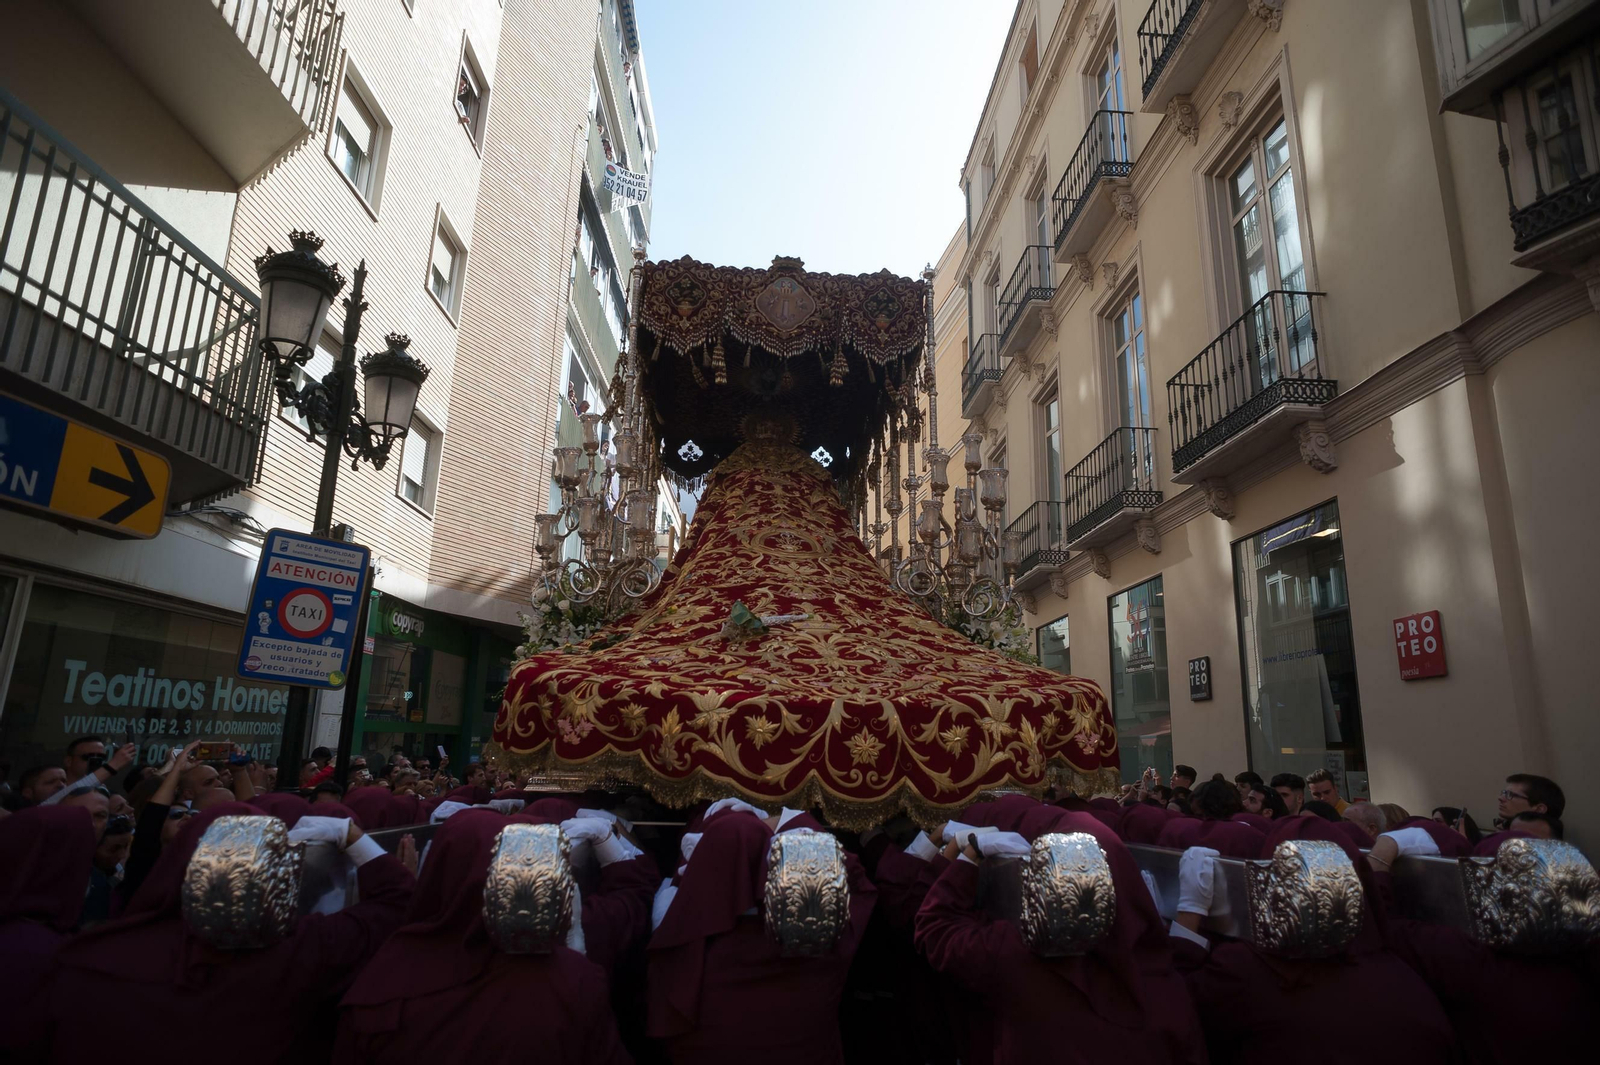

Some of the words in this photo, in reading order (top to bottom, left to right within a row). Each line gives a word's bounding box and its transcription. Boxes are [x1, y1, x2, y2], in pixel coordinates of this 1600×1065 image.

[617, 175, 648, 189] KRAUEL
[619, 168, 646, 181] VENDE
[616, 182, 624, 196] 21
[626, 187, 635, 200] 04
[637, 189, 648, 202] 57
[271, 562, 357, 587] ATENCIÓN
[291, 605, 323, 620] TAXI
[393, 611, 425, 638] copyrap
[1395, 615, 1435, 639] PRO
[252, 639, 293, 652] Excepto
[296, 646, 328, 656] bajada
[1397, 636, 1438, 658] TEO
[270, 654, 313, 665] usuarios
[1189, 659, 1207, 674] PRO
[63, 659, 206, 711] Teatinos
[1189, 672, 1208, 687] TEO
[148, 719, 165, 734] DE
[168, 719, 179, 736] 2,
[183, 719, 192, 734] 3
[195, 720, 203, 734] Y
[204, 720, 212, 734] 4
